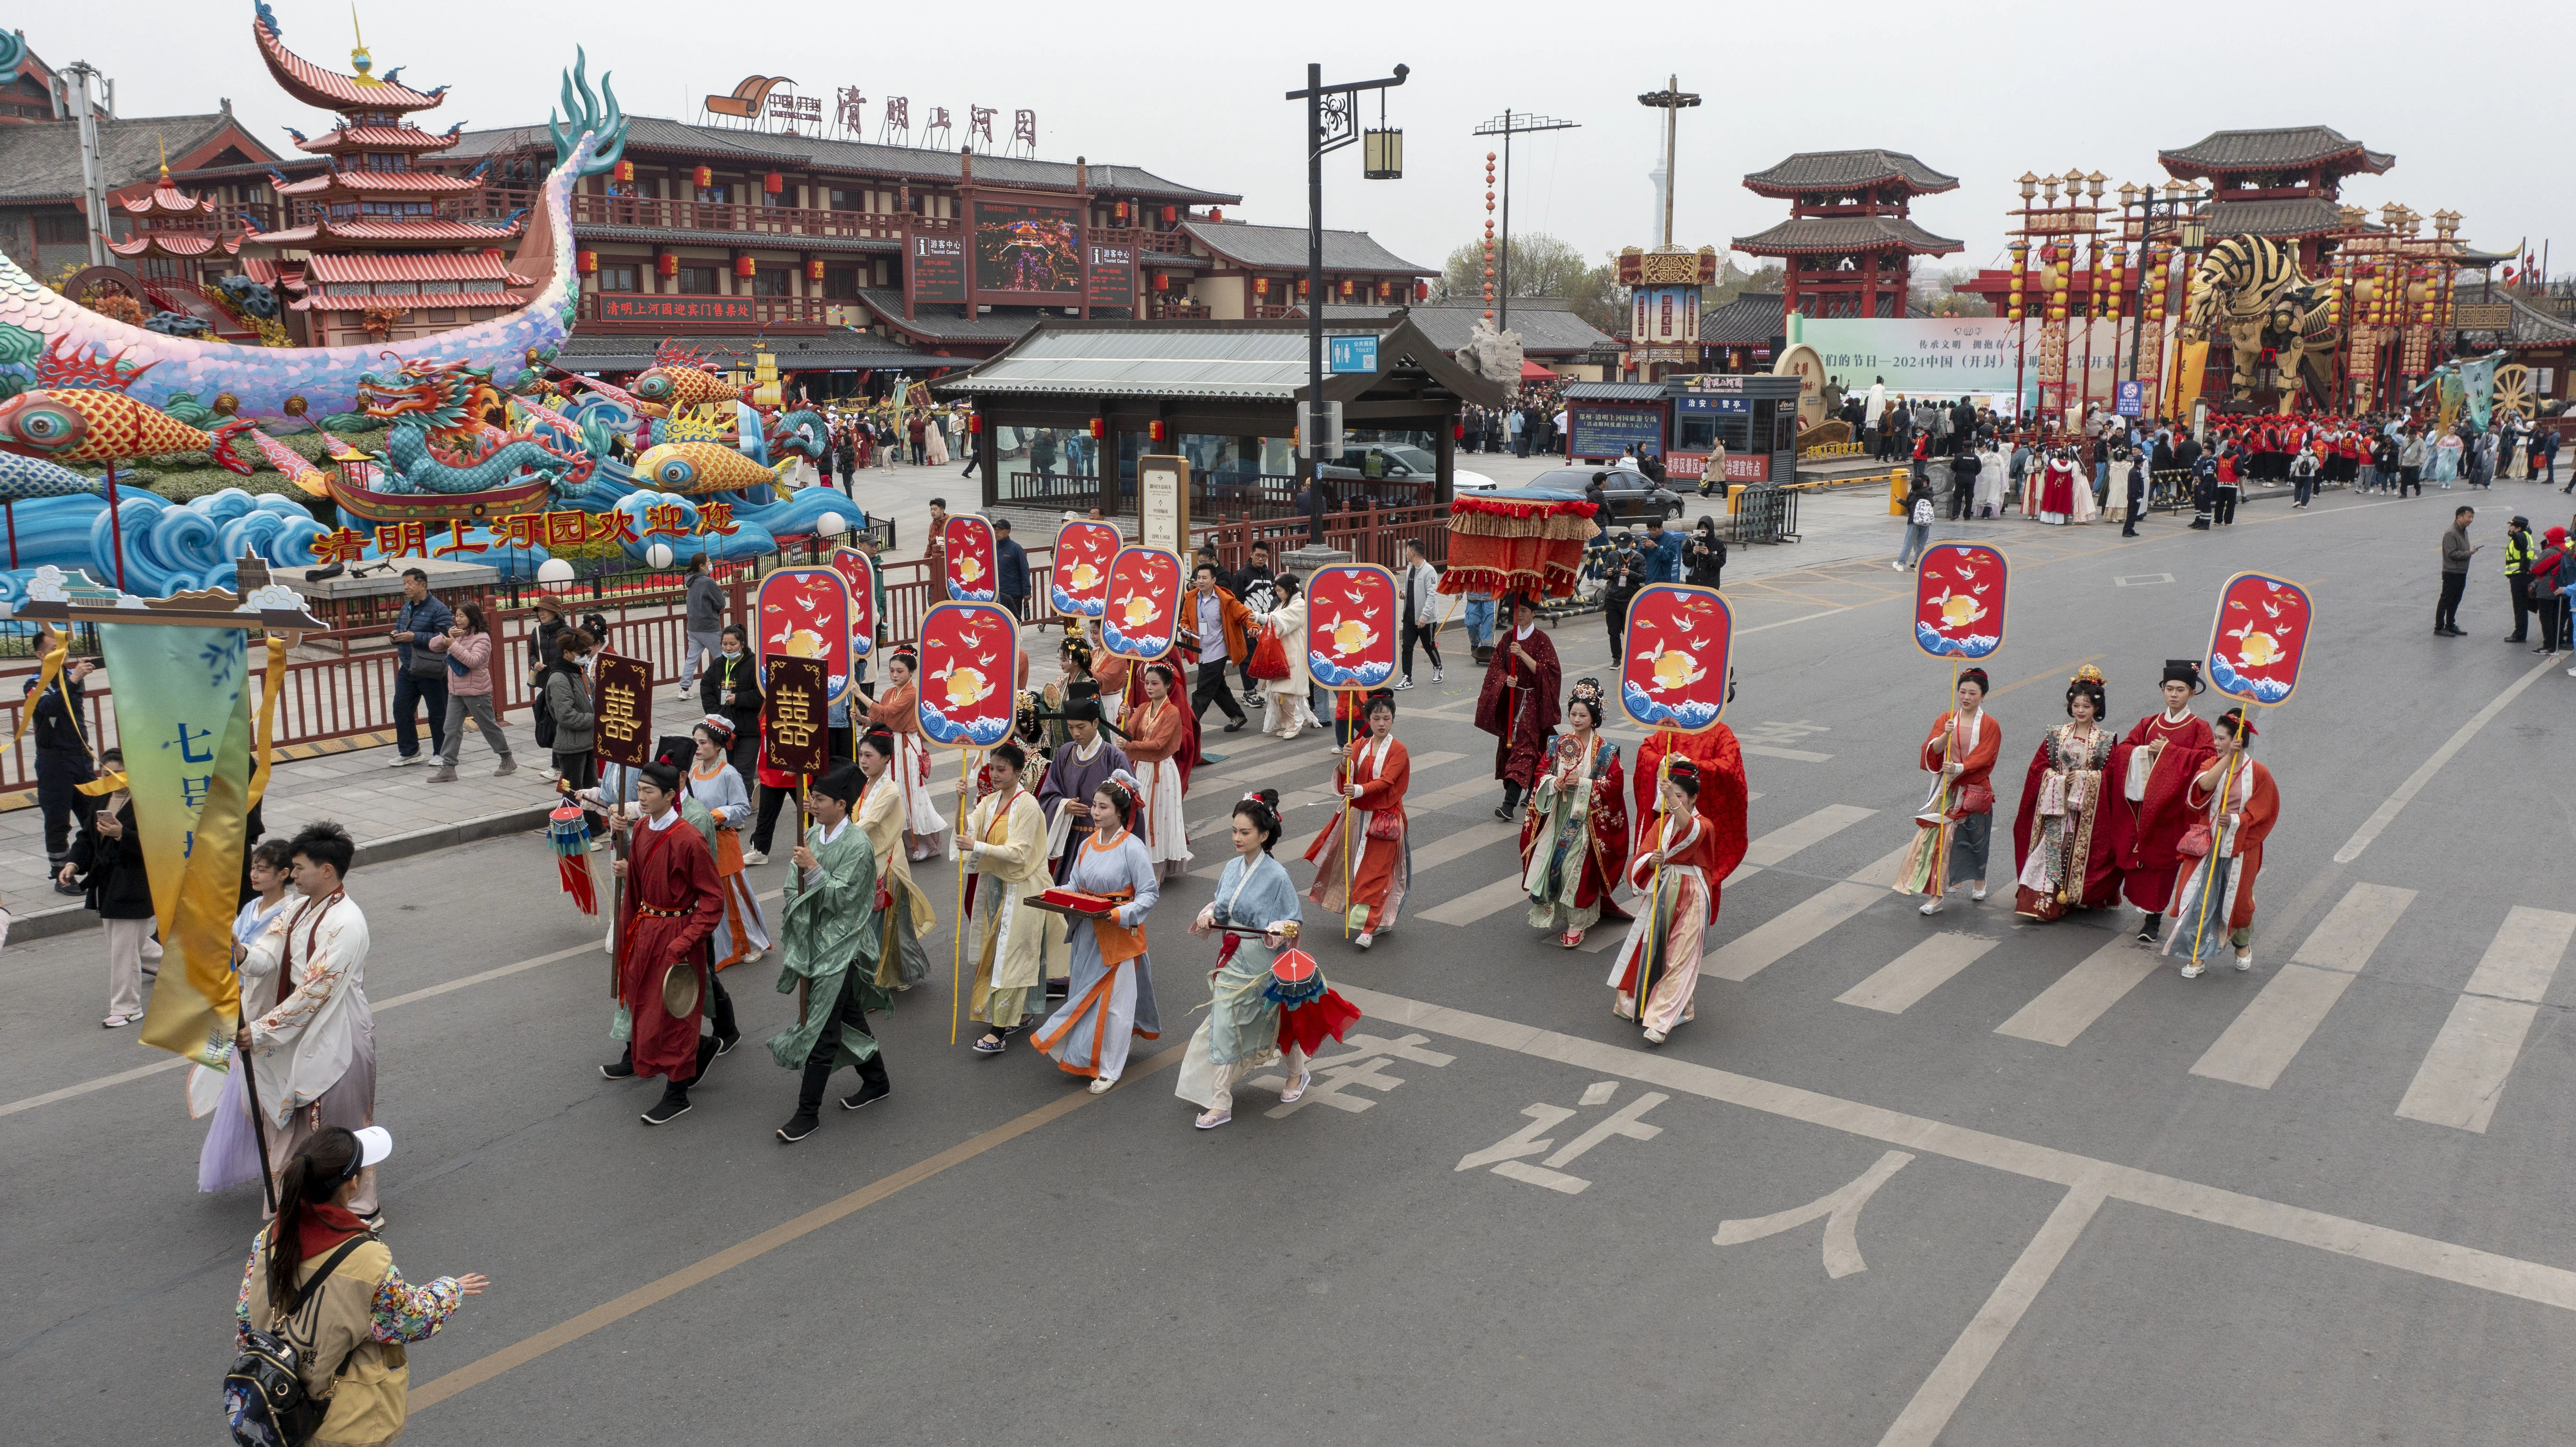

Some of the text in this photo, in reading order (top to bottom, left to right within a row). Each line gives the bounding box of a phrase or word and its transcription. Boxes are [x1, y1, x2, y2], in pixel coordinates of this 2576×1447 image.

[837, 84, 1036, 147] 清明上河园
[931, 239, 961, 249] 游客中心
[1104, 249, 1130, 258] 游客中心
[606, 301, 749, 317] 清明上河园迎宾门售票处
[1919, 339, 1961, 349] 传承文明
[1688, 399, 1741, 409] 治安 警亭
[1579, 413, 1657, 422] 郑州-清明上河园旅游专线
[310, 501, 740, 563] 清明上河园欢迎您
